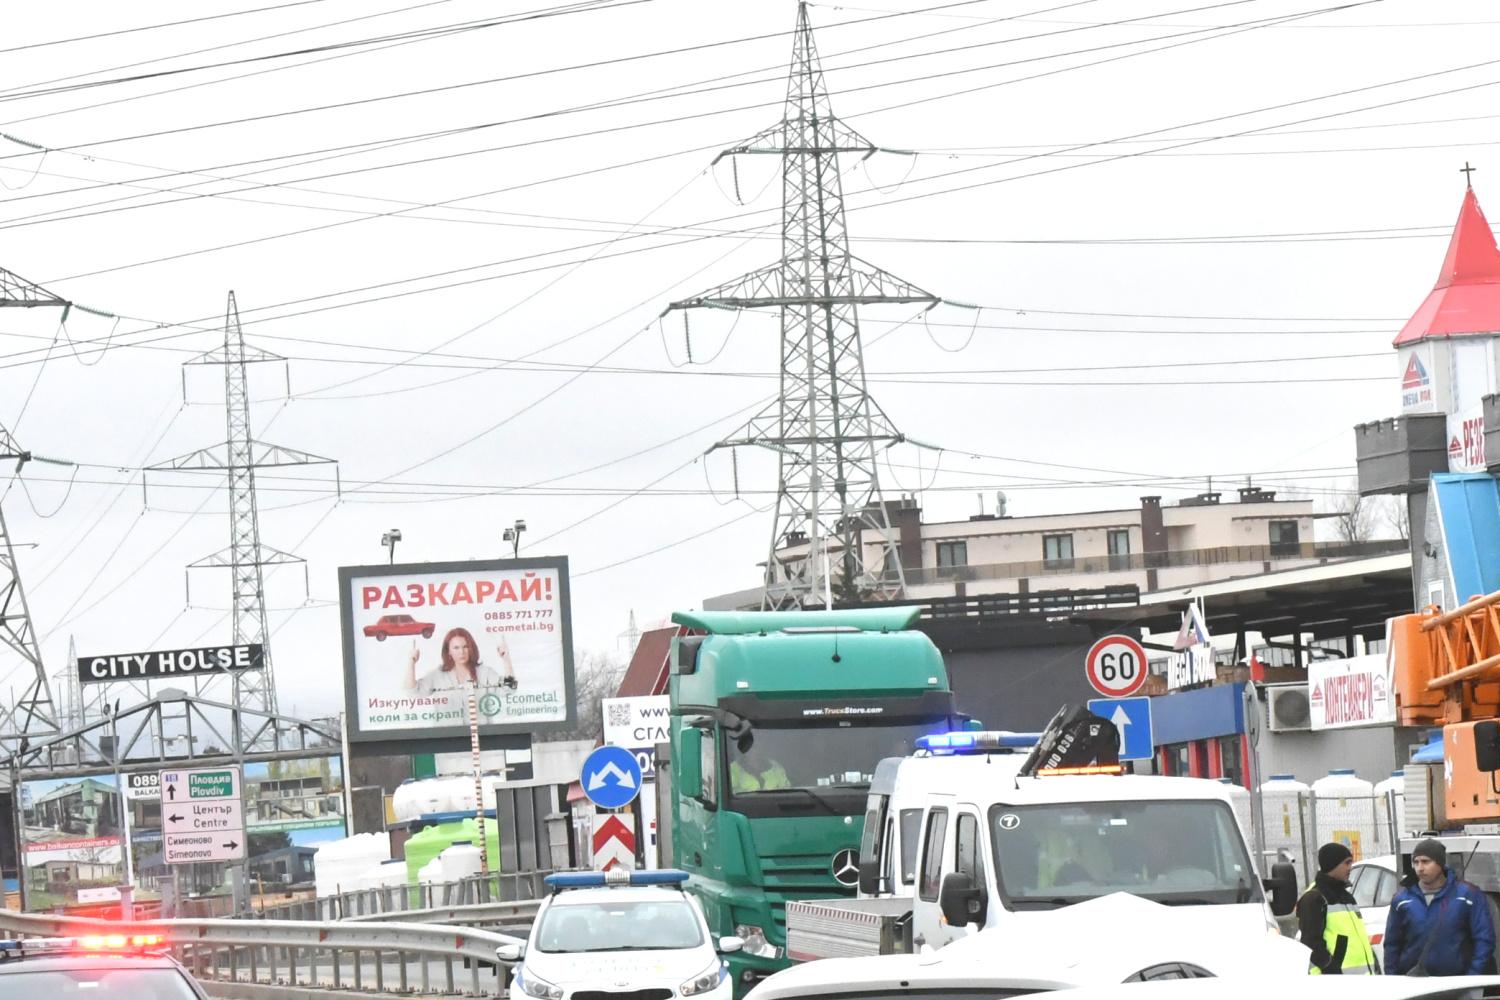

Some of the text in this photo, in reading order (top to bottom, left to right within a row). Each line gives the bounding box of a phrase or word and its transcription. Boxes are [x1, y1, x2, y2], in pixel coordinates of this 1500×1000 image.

[362, 572, 553, 609] РАЗКАРАЙ!
[484, 609, 553, 621] 0885 771 777
[486, 622, 554, 633] ecometal.bg
[91, 646, 250, 677] CITY HOUSE
[1101, 652, 1134, 681] 60
[368, 697, 449, 709] Изкупуваме
[506, 691, 558, 704] Ecometal
[369, 709, 464, 723] коли за скрап!
[506, 706, 558, 717] Engineering
[133, 774, 160, 786] 089
[190, 774, 231, 784] Пловдив
[135, 788, 160, 797] BALKA
[191, 786, 224, 796] Plovdiv
[193, 805, 232, 815] Център
[194, 818, 228, 828] Centre
[168, 836, 213, 846] Симеоново
[168, 850, 211, 860] Simeonovo
